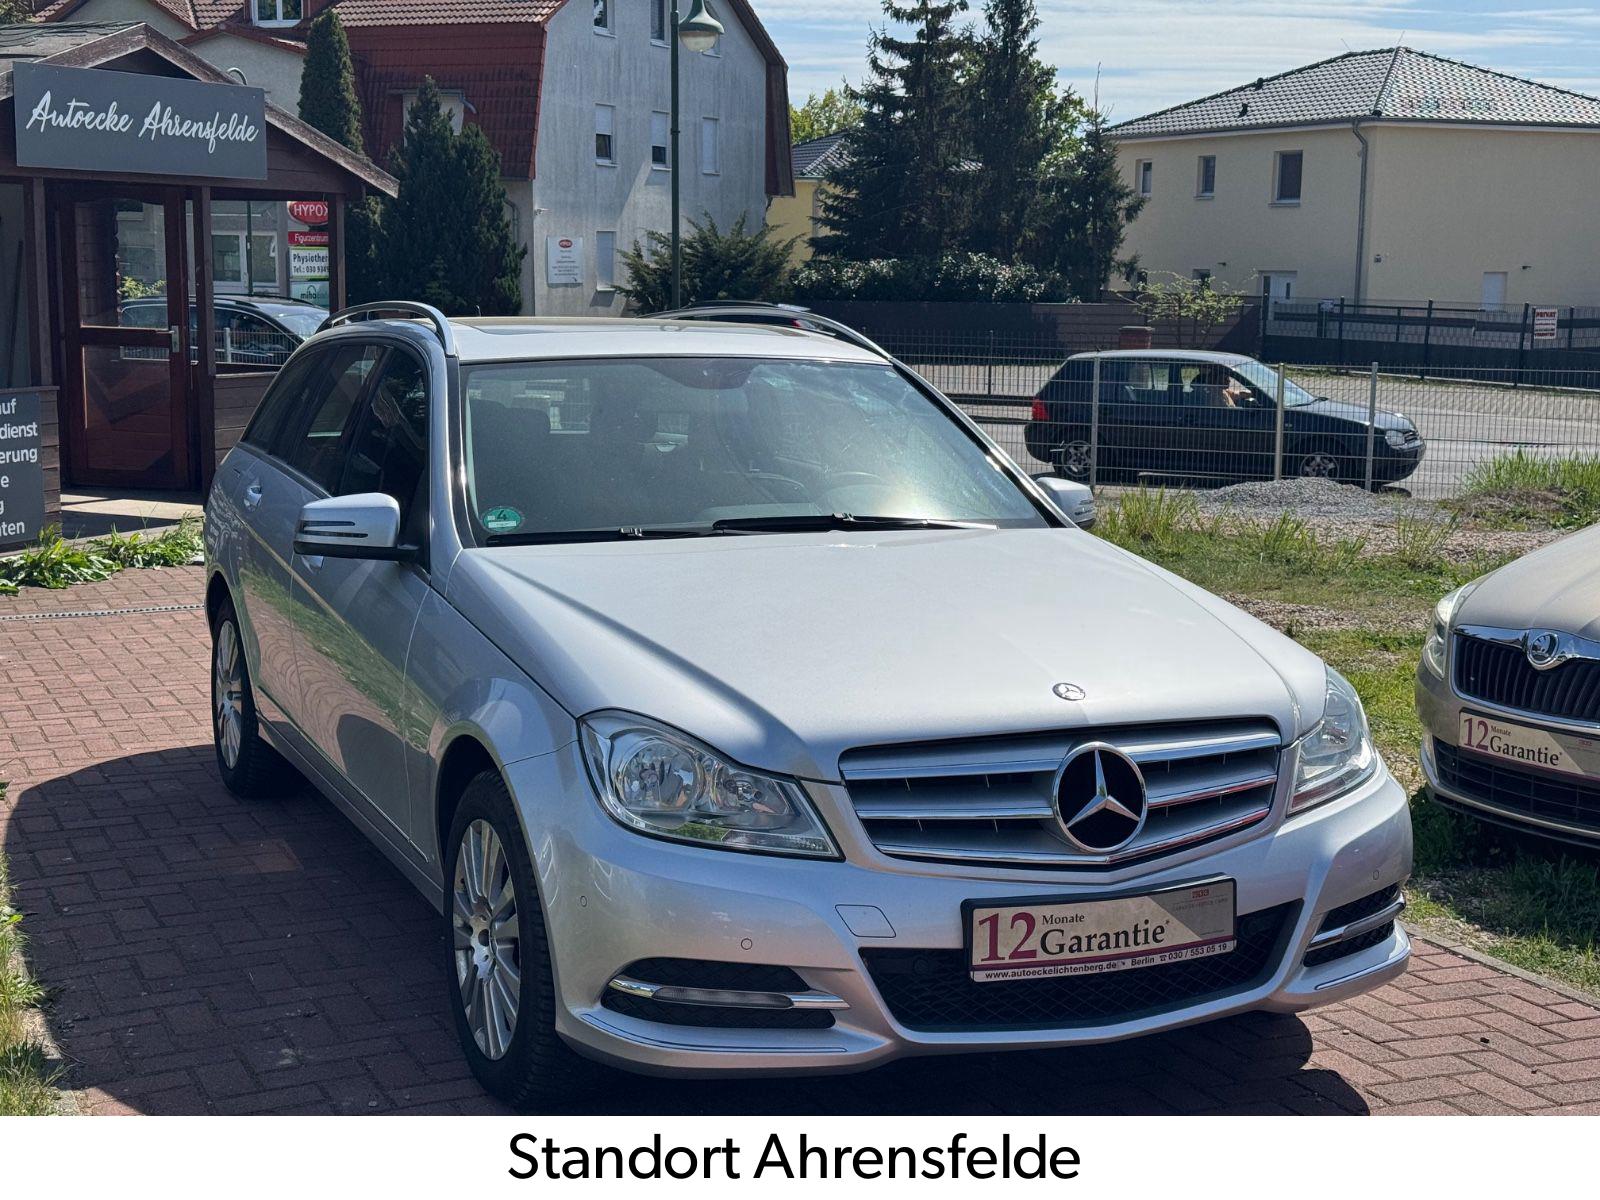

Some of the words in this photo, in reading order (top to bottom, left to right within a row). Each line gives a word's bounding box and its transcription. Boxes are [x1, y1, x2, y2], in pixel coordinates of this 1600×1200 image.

[26, 90, 133, 132] Autoecke
[138, 101, 259, 153] Ahrensfelde
[0, 398, 17, 415] uf
[0, 421, 38, 440] dienst
[496, 509, 508, 521] 4
[0, 521, 25, 537] ten
[1463, 717, 1489, 751] 12
[1490, 725, 1512, 737] Monate
[1042, 914, 1085, 926] Monate
[978, 911, 1037, 962] 12
[985, 960, 1117, 979] www.autoeckelichtenberg.de
[1131, 956, 1155, 967] Berlin
[1168, 951, 1183, 960] 030
[1190, 947, 1205, 957] 553
[1206, 944, 1216, 953] 05
[1218, 942, 1227, 952] 19
